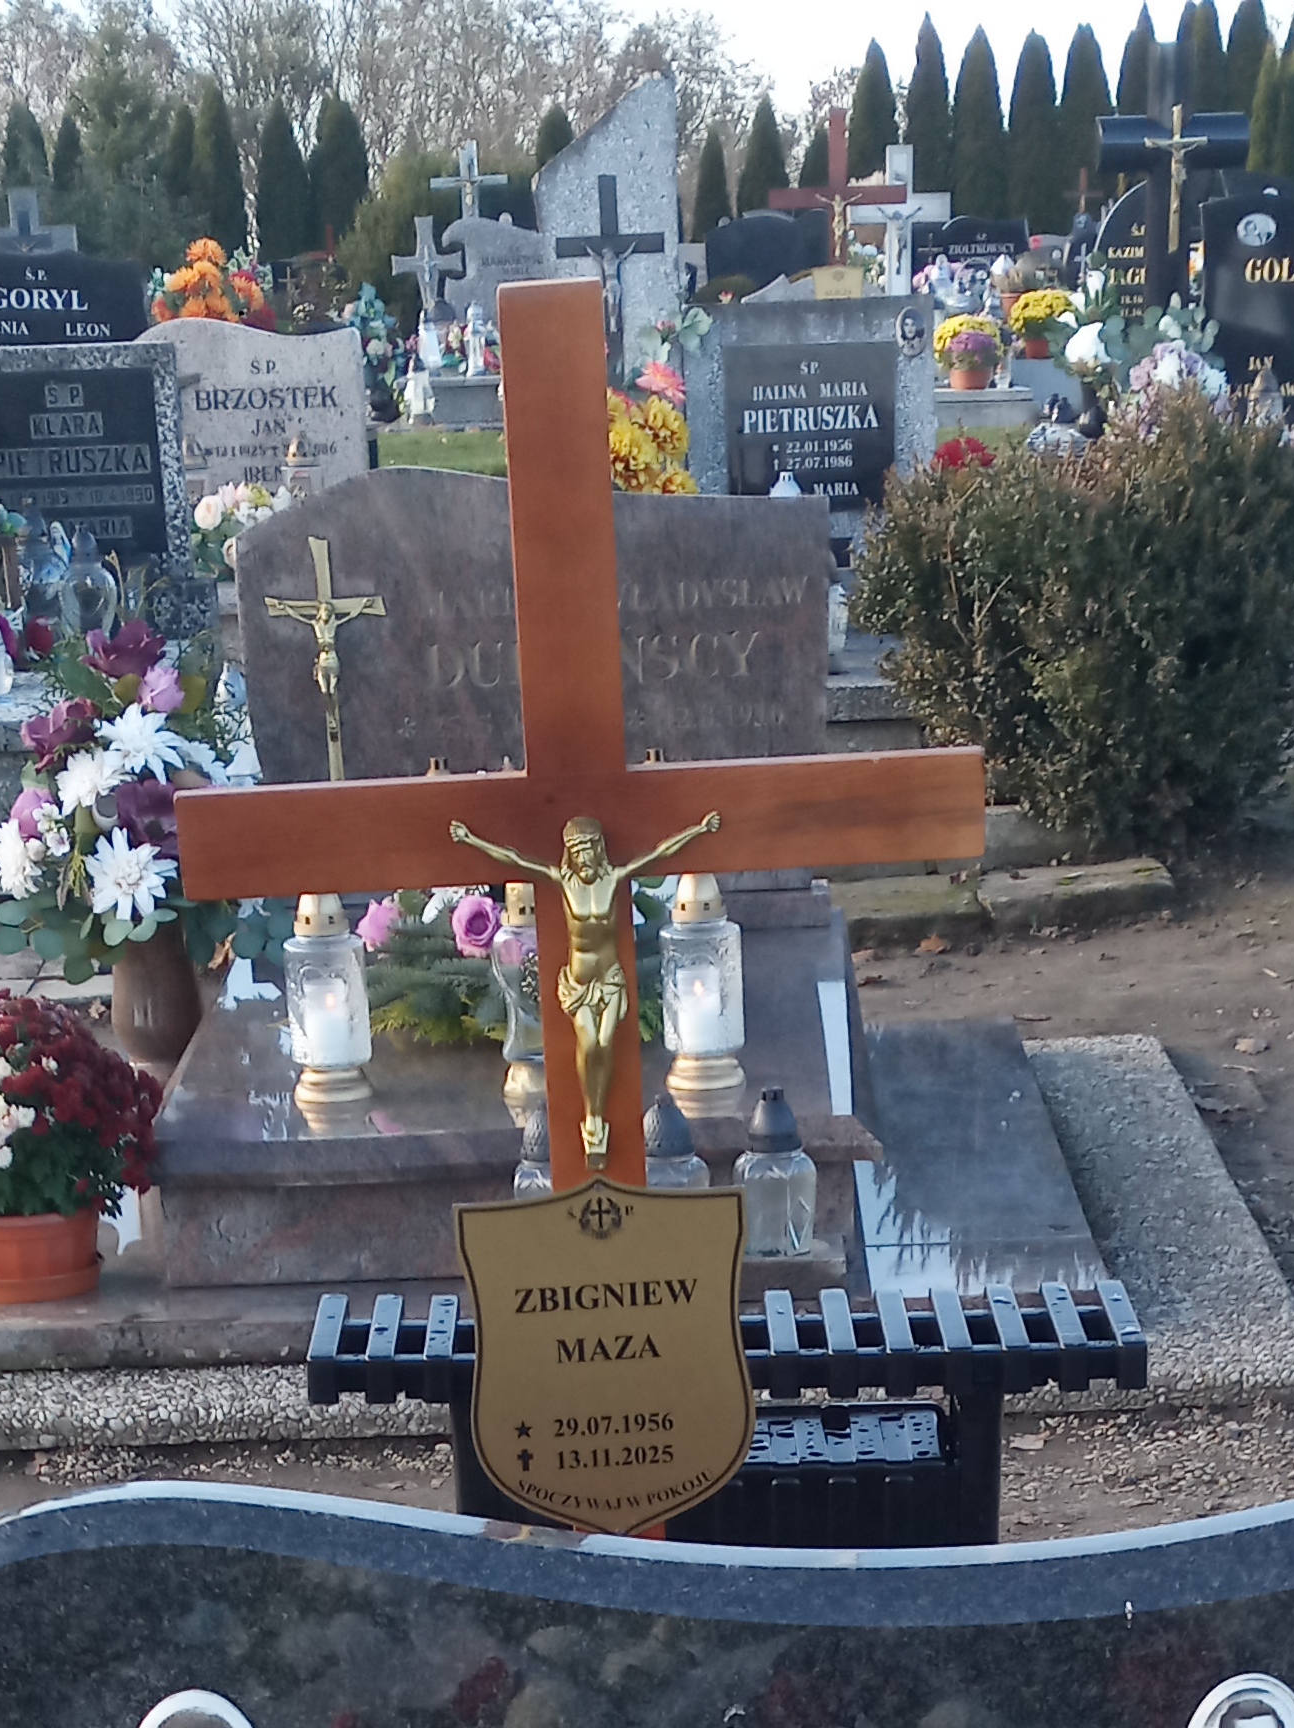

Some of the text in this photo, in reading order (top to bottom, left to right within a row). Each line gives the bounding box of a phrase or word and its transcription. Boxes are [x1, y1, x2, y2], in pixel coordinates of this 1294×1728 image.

[1107, 245, 1145, 260] KAZIM
[65, 322, 111, 338] LEON
[194, 385, 339, 411] BRZOSTEK
[752, 381, 869, 402] HALINA MARIA
[32, 413, 102, 437] KLARA
[250, 418, 287, 437] JAN
[742, 403, 879, 435] PIETRUSZKA
[243, 465, 284, 483] IREN
[514, 1278, 698, 1314] ZBIGNIEW
[556, 1334, 661, 1364] MAZA
[553, 1412, 674, 1438] 29.07.1956
[557, 1444, 674, 1470] 13.11.2025
[517, 1469, 713, 1511] SPOCZYWAJ W POKOJU
